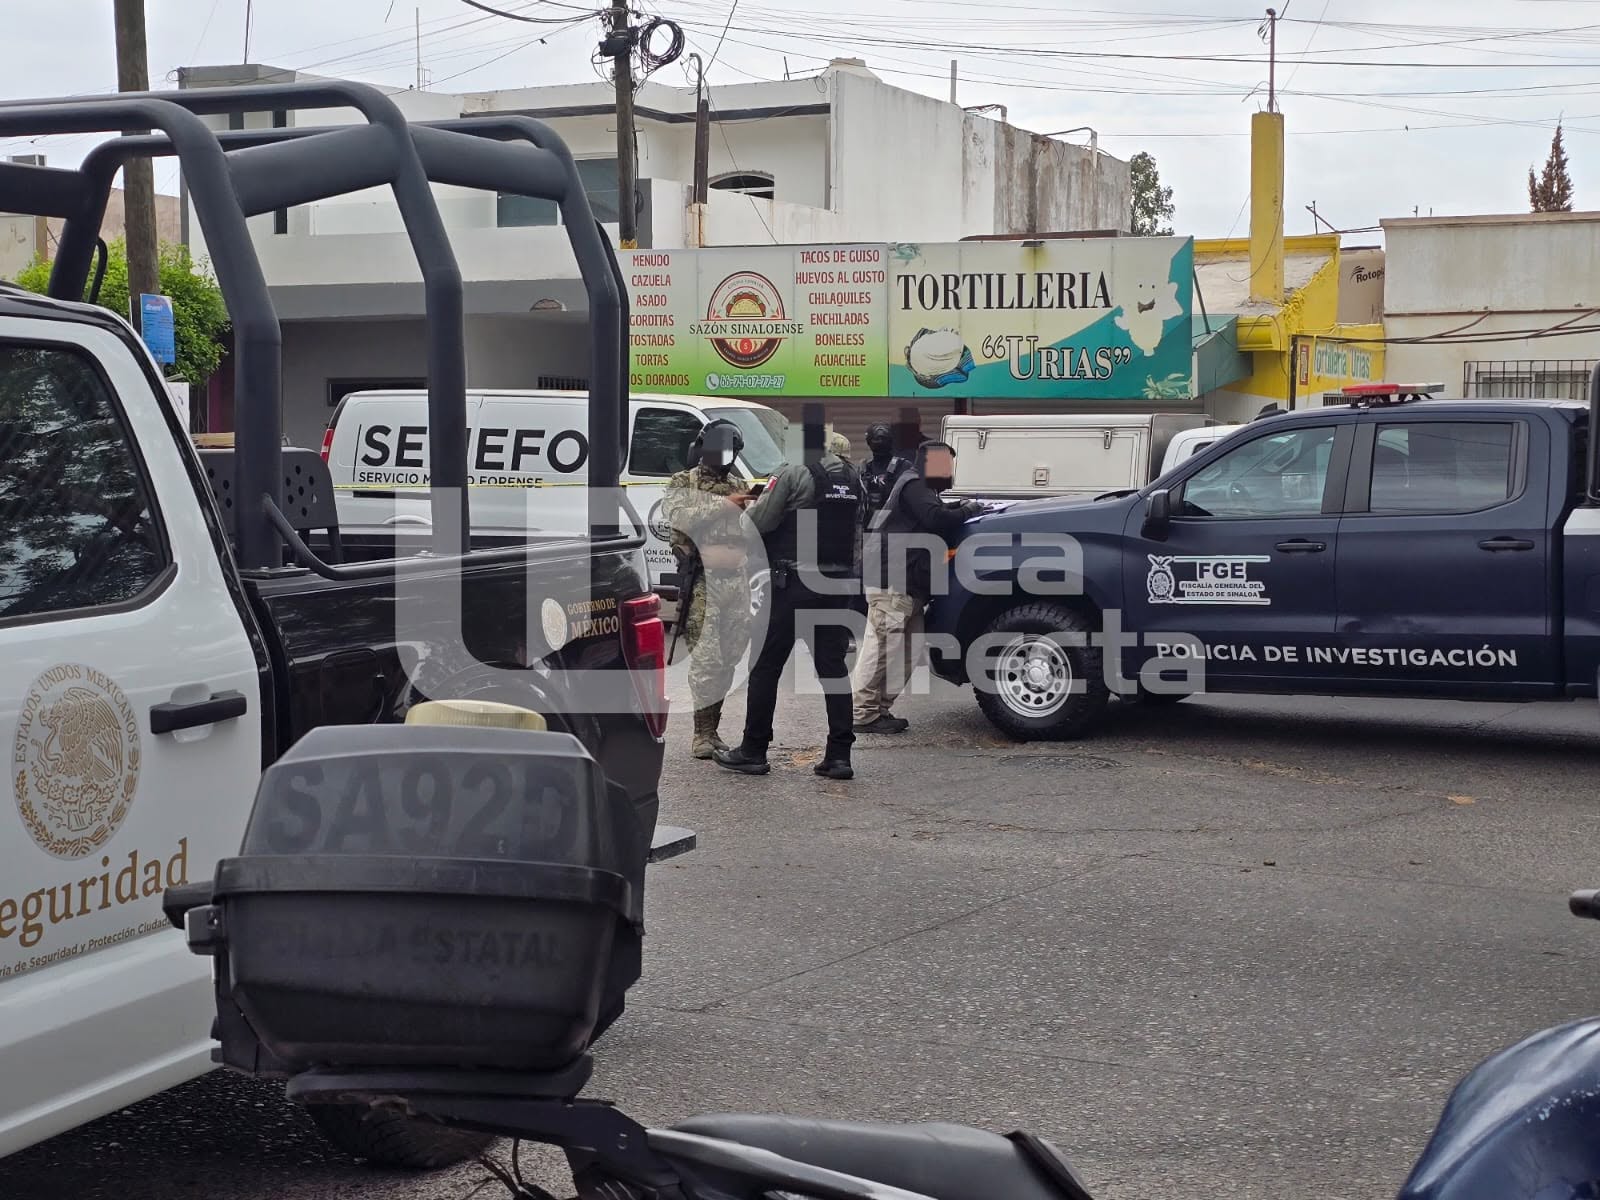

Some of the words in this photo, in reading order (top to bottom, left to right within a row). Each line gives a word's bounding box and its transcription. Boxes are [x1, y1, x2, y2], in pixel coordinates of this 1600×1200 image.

[632, 254, 670, 267] MENUDO
[800, 250, 830, 264] TACOS
[833, 250, 846, 263] DE
[849, 249, 880, 263] GUISO
[631, 274, 671, 287] CAZUELA
[795, 271, 835, 284] HUEVOS
[837, 271, 849, 284] AL
[852, 270, 885, 284] GUSTO
[1356, 268, 1385, 283] Rotop
[896, 271, 1114, 311] TORTILLERIA
[635, 294, 667, 307] ASADO
[628, 314, 675, 327] GORDITAS
[810, 312, 870, 326] ENCHILADAS
[689, 321, 727, 335] SAZÓN
[730, 322, 804, 335] SINALOENSE
[629, 334, 675, 347] TOSTADAS
[815, 333, 865, 346] BONELESS
[635, 354, 669, 366] TORTAS
[814, 354, 866, 367] AGUACHILE
[645, 374, 690, 387] DORADOS
[820, 374, 860, 387] CEVICHE
[361, 424, 589, 474] SEEFO
[358, 471, 418, 485] SERVICIO
[1198, 562, 1246, 580] FGE
[1181, 581, 1213, 590] FISCALÍA
[567, 599, 606, 615] GOBIERNO
[606, 598, 617, 609] DE
[570, 614, 619, 639] MÉXICO
[1156, 642, 1257, 662] POLICIA
[1263, 645, 1299, 662] DE
[1306, 644, 1518, 667] INVESTIGACIÓN
[16, 689, 42, 764] ESTADOS
[38, 664, 82, 692] UNIDOS
[86, 666, 138, 743] MEXICANOS
[0, 836, 189, 948] eguridad
[14, 959, 28, 973] de
[30, 942, 79, 969] Seguridad
[79, 942, 87, 955] y
[88, 926, 137, 950] Protección
